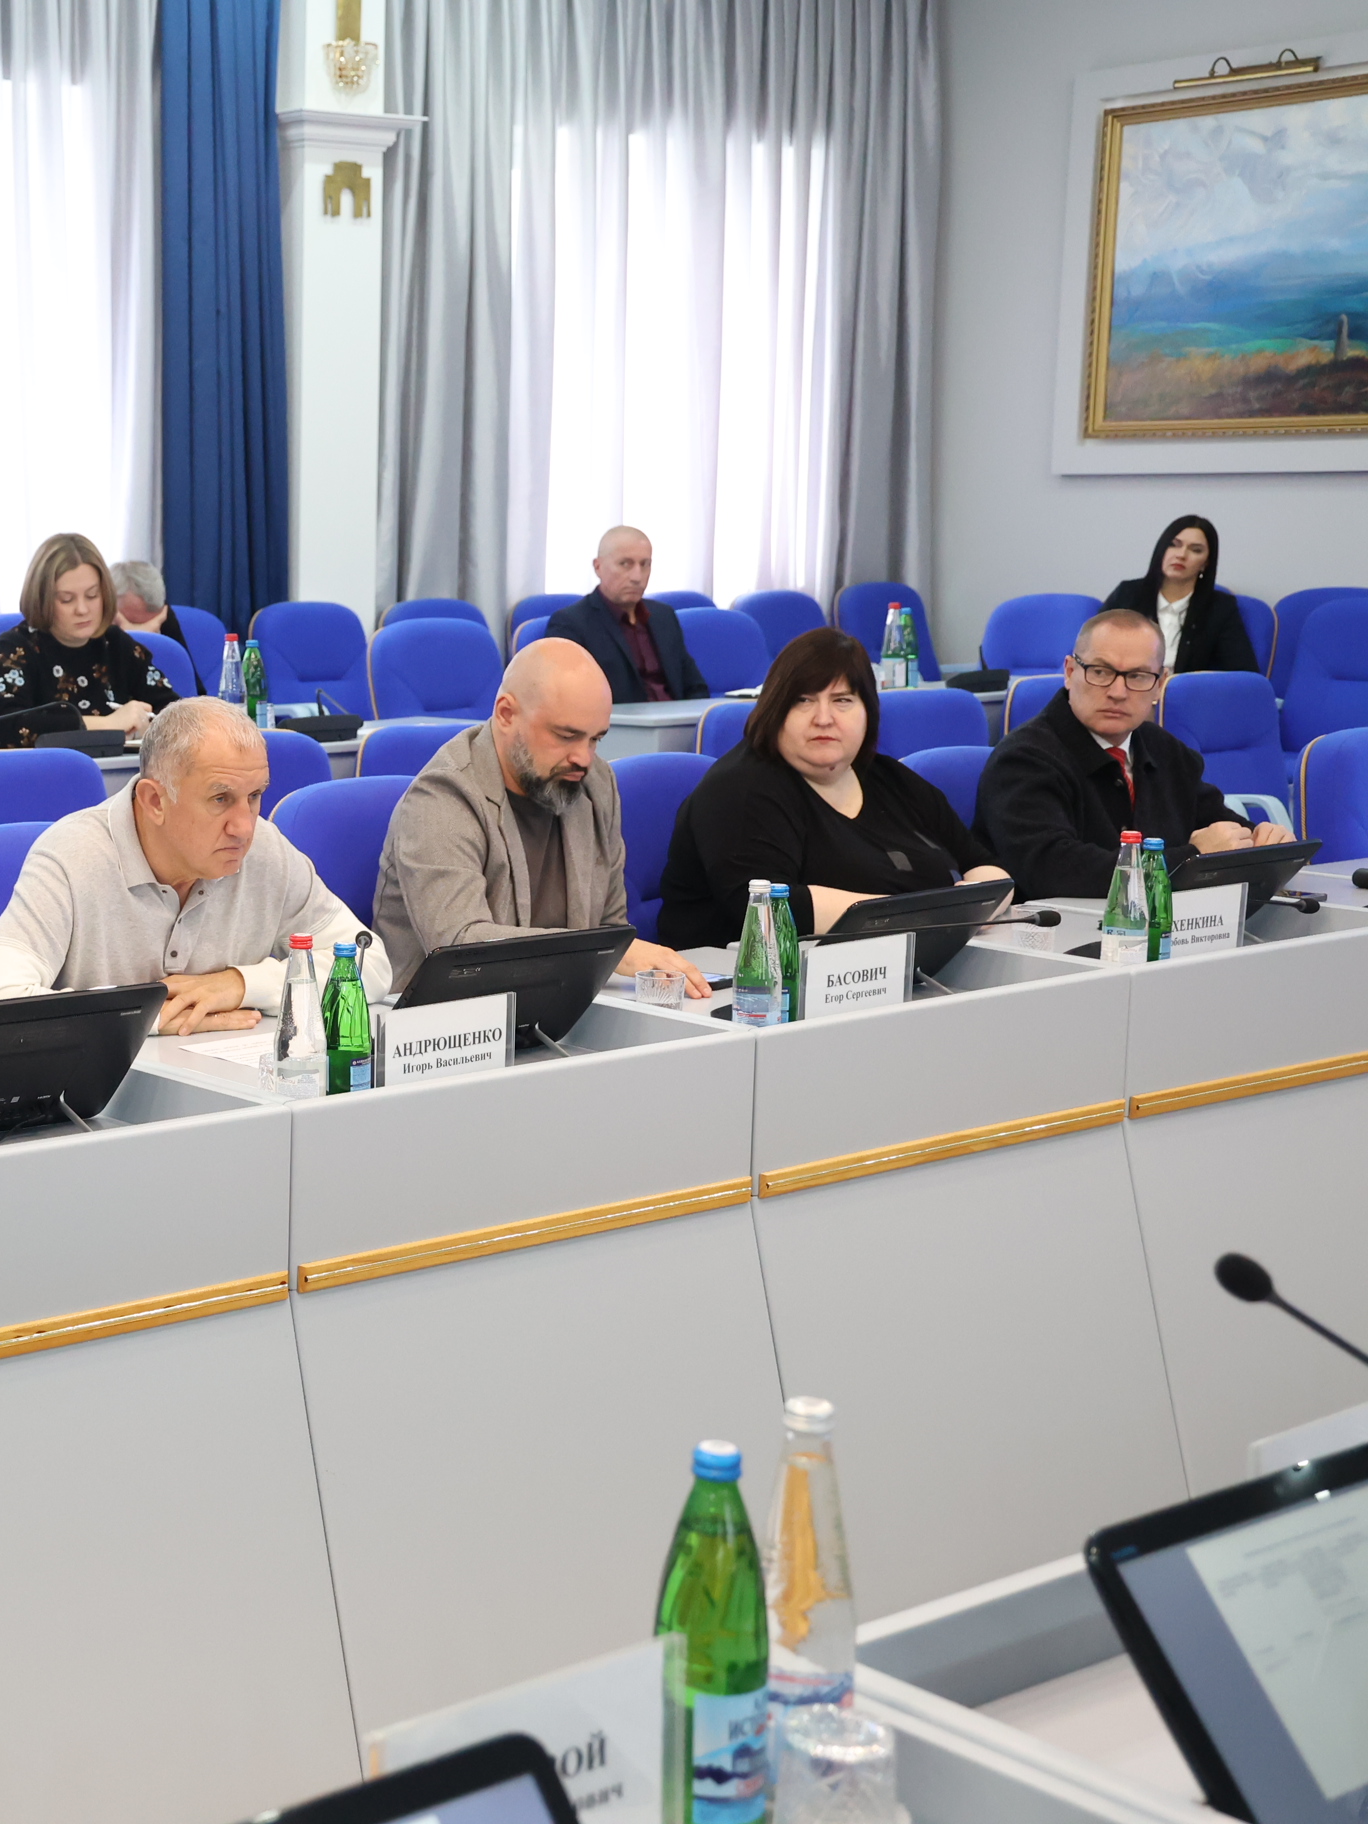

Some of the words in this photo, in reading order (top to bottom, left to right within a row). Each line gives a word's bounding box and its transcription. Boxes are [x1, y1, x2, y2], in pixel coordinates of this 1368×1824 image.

[1172, 914, 1224, 933] ХЕНКИНА
[1190, 932, 1231, 944] Викторовна
[826, 966, 888, 988] БАСОВИЧ
[824, 993, 844, 1004] Егор
[845, 986, 888, 1002] Сергеевич
[392, 1027, 503, 1058] АНДРЮЩЕНКО
[403, 1061, 434, 1075] Игорь
[435, 1051, 493, 1069] Васильевич
